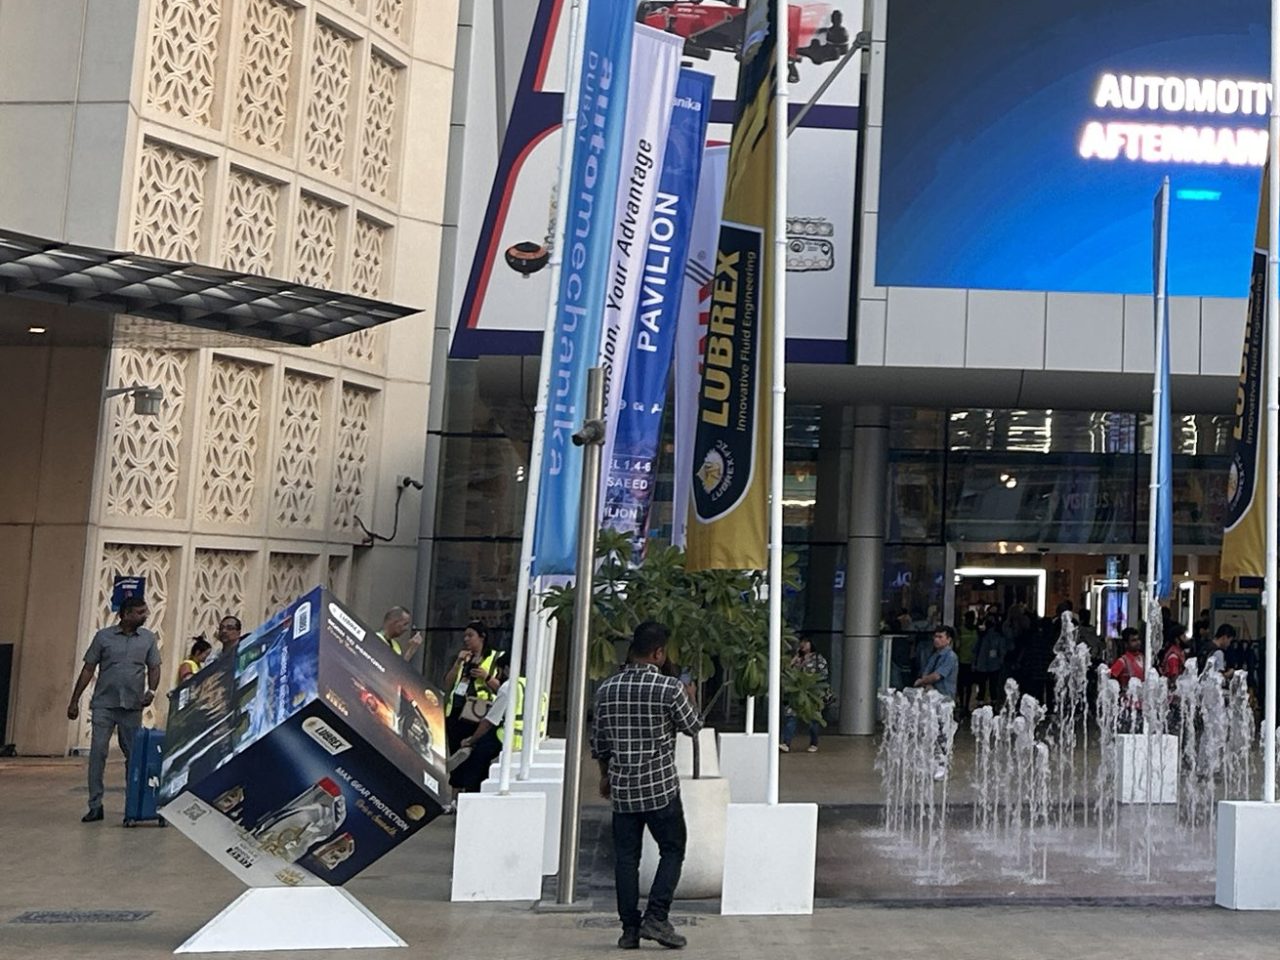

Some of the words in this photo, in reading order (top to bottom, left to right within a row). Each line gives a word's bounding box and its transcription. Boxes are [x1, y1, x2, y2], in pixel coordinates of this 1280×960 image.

[578, 51, 599, 143] DUBAI
[548, 55, 614, 477] automechanika
[606, 260, 629, 319] Your
[618, 138, 653, 258] Advantage
[637, 192, 680, 353] PAVILION
[741, 251, 756, 327] Engineering
[702, 249, 741, 428] LUBREX
[739, 330, 752, 361] Fluid
[736, 364, 750, 432] Innovative
[314, 726, 345, 751] LUBREX
[335, 767, 352, 782] MAX
[350, 778, 370, 798] GEAR
[369, 795, 410, 831] PROTECTION
